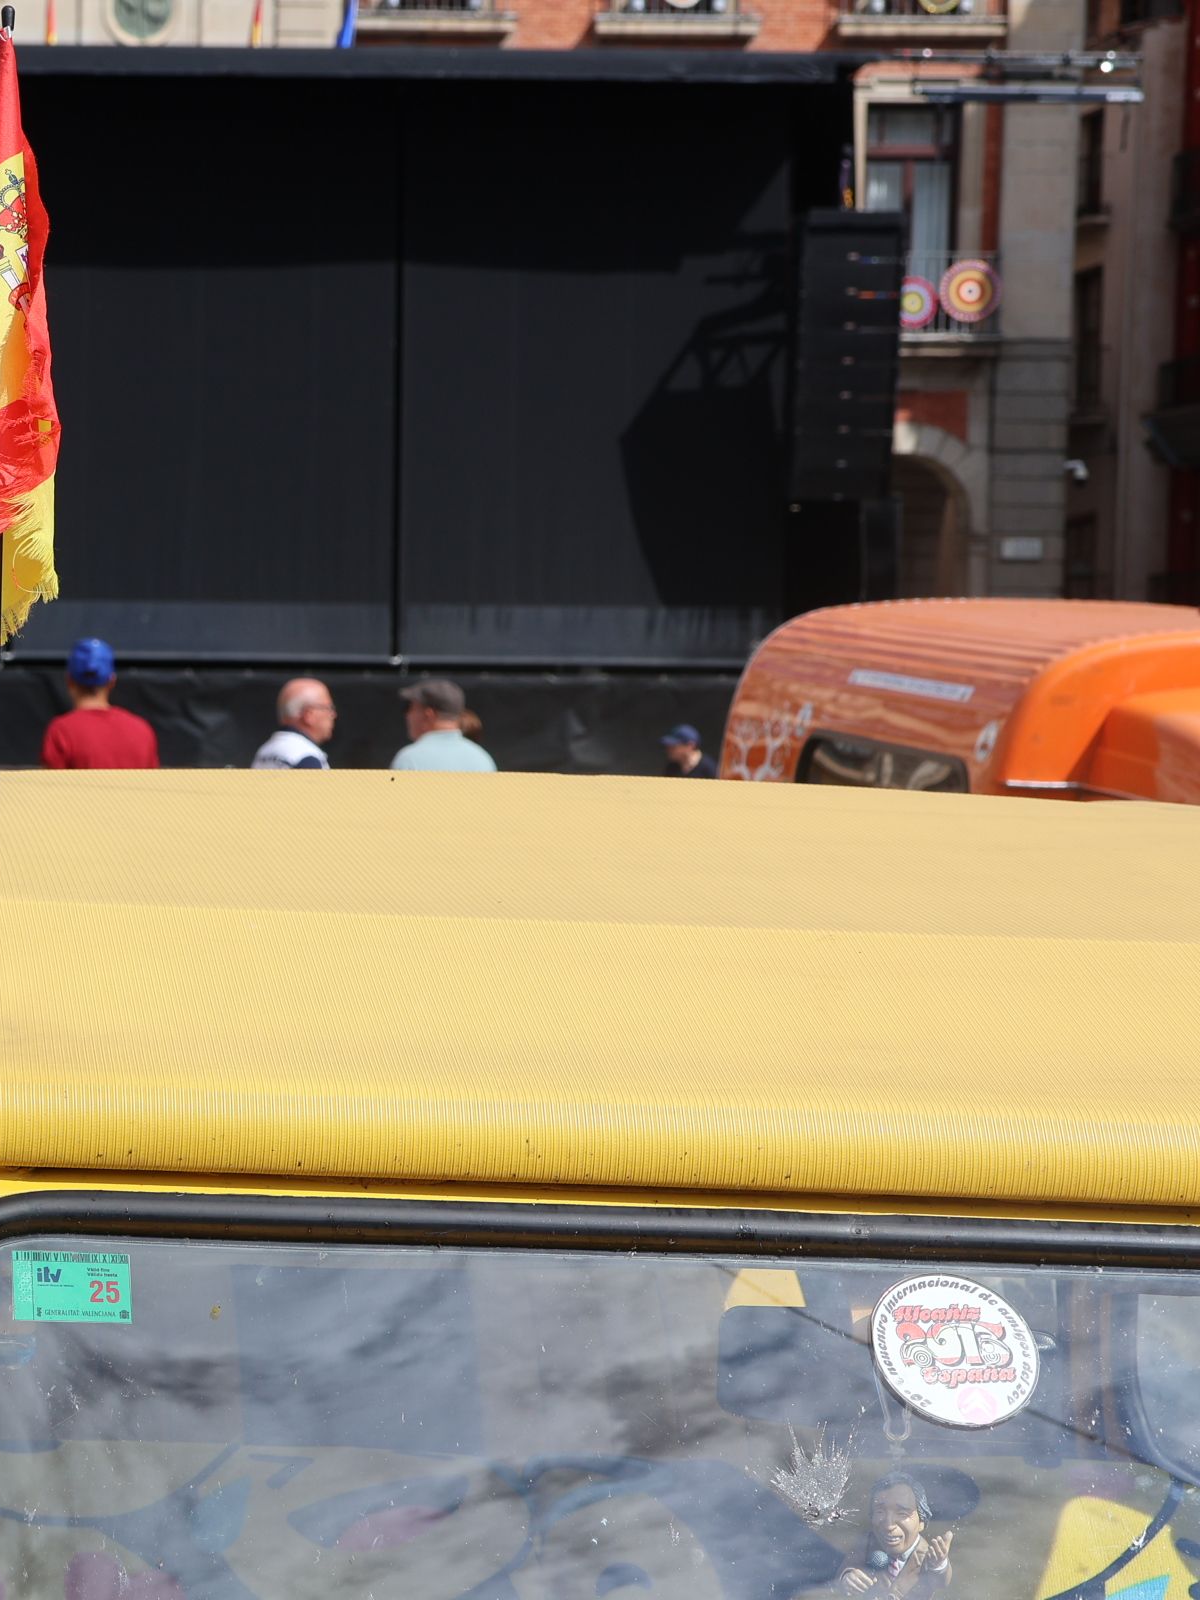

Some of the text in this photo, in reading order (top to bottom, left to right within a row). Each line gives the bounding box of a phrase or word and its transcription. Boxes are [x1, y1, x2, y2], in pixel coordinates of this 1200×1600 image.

[42, 1252, 50, 1261] IV
[53, 1252, 59, 1261] V
[91, 1253, 99, 1263] IX
[101, 1254, 107, 1263] X
[36, 1266, 62, 1282] itv
[89, 1280, 120, 1303] 25
[44, 1308, 116, 1318] GENERALITAT VALENCIANA
[892, 1303, 981, 1323] Alcañiz
[883, 1277, 978, 1314] internacional
[978, 1292, 998, 1306] de
[998, 1307, 1032, 1358] amigos
[1021, 1361, 1034, 1387] del
[920, 1366, 1017, 1389] España
